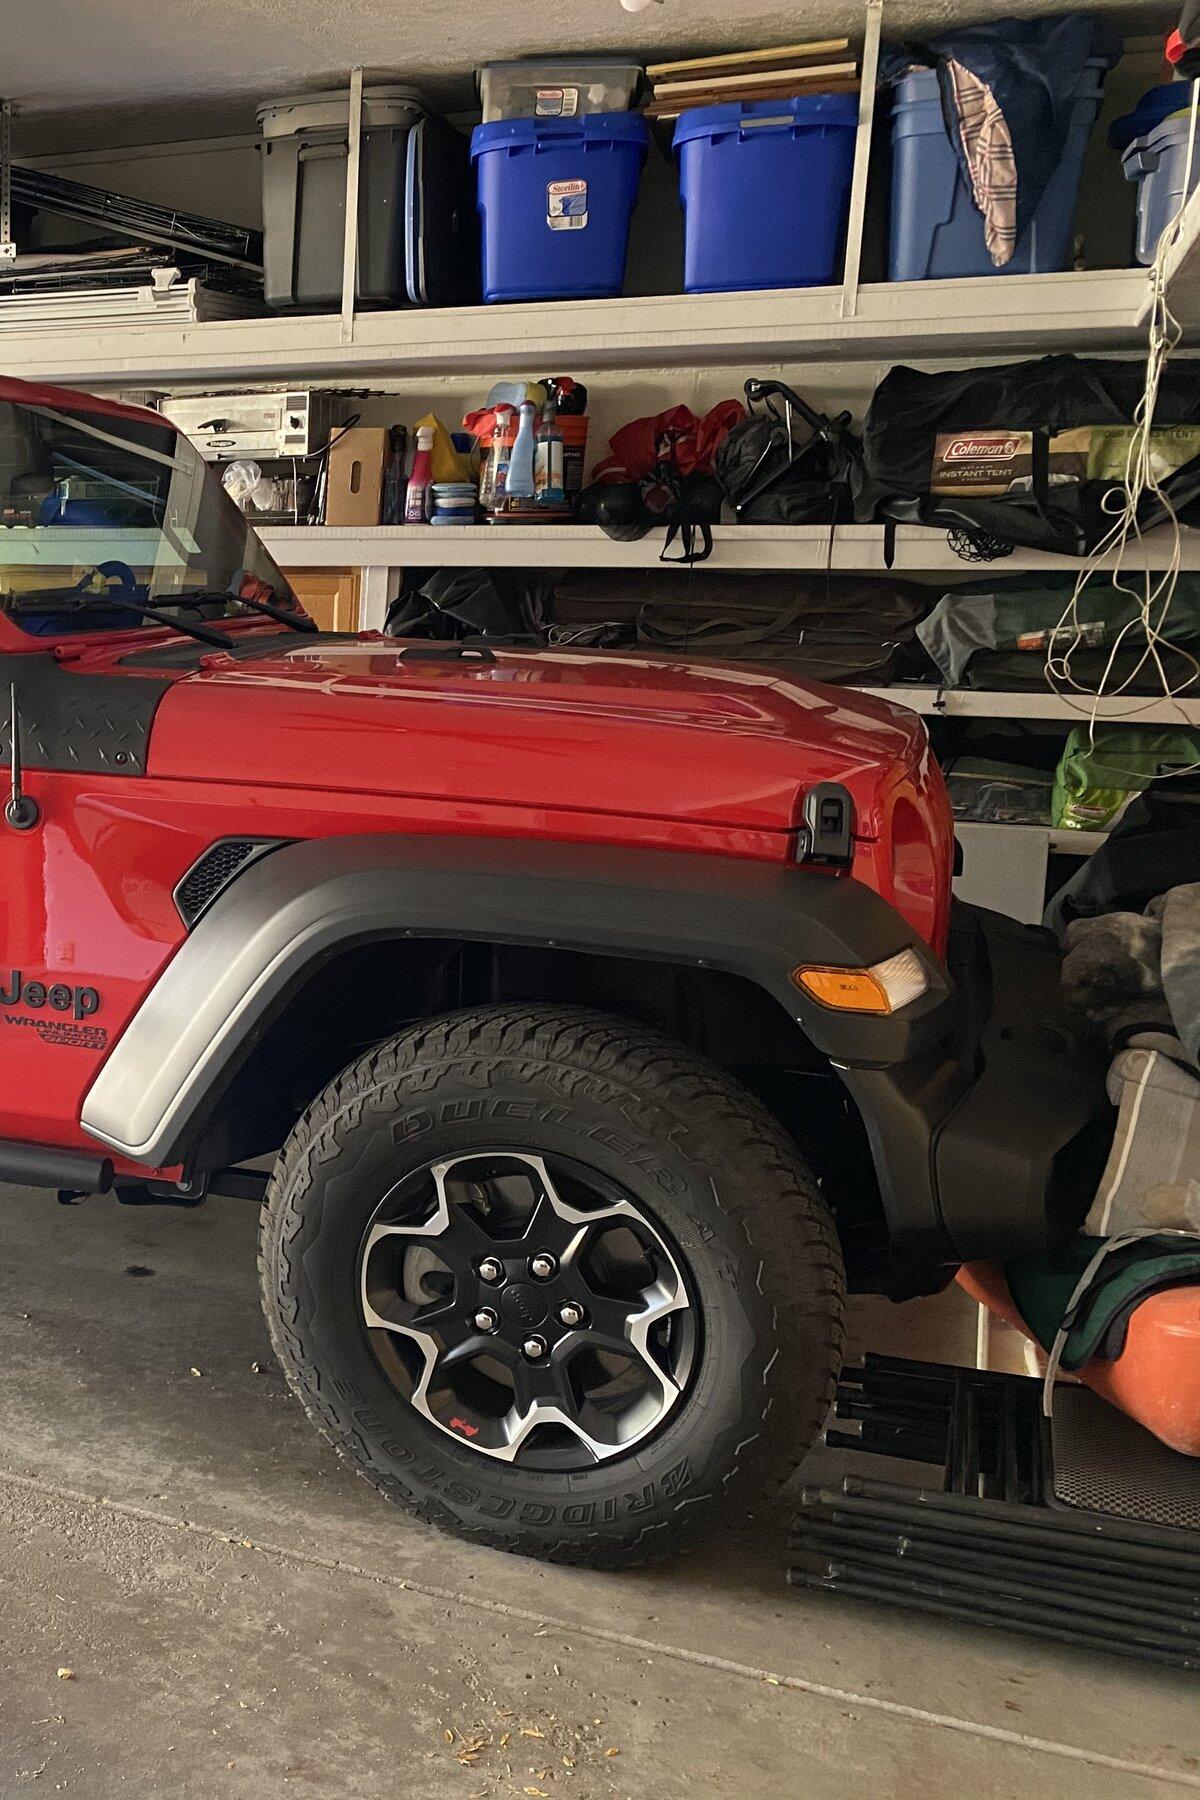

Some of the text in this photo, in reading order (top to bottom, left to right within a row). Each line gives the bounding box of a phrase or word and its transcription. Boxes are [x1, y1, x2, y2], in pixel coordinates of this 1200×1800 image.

[1169, 429, 1195, 438] TENT
[951, 442, 1004, 456] Coleman
[939, 470, 984, 478] INSTANT
[4, 1014, 108, 1037] WRANGLER
[390, 1098, 689, 1198] DUELER
[331, 1378, 694, 1529] BRIDGESTONE
